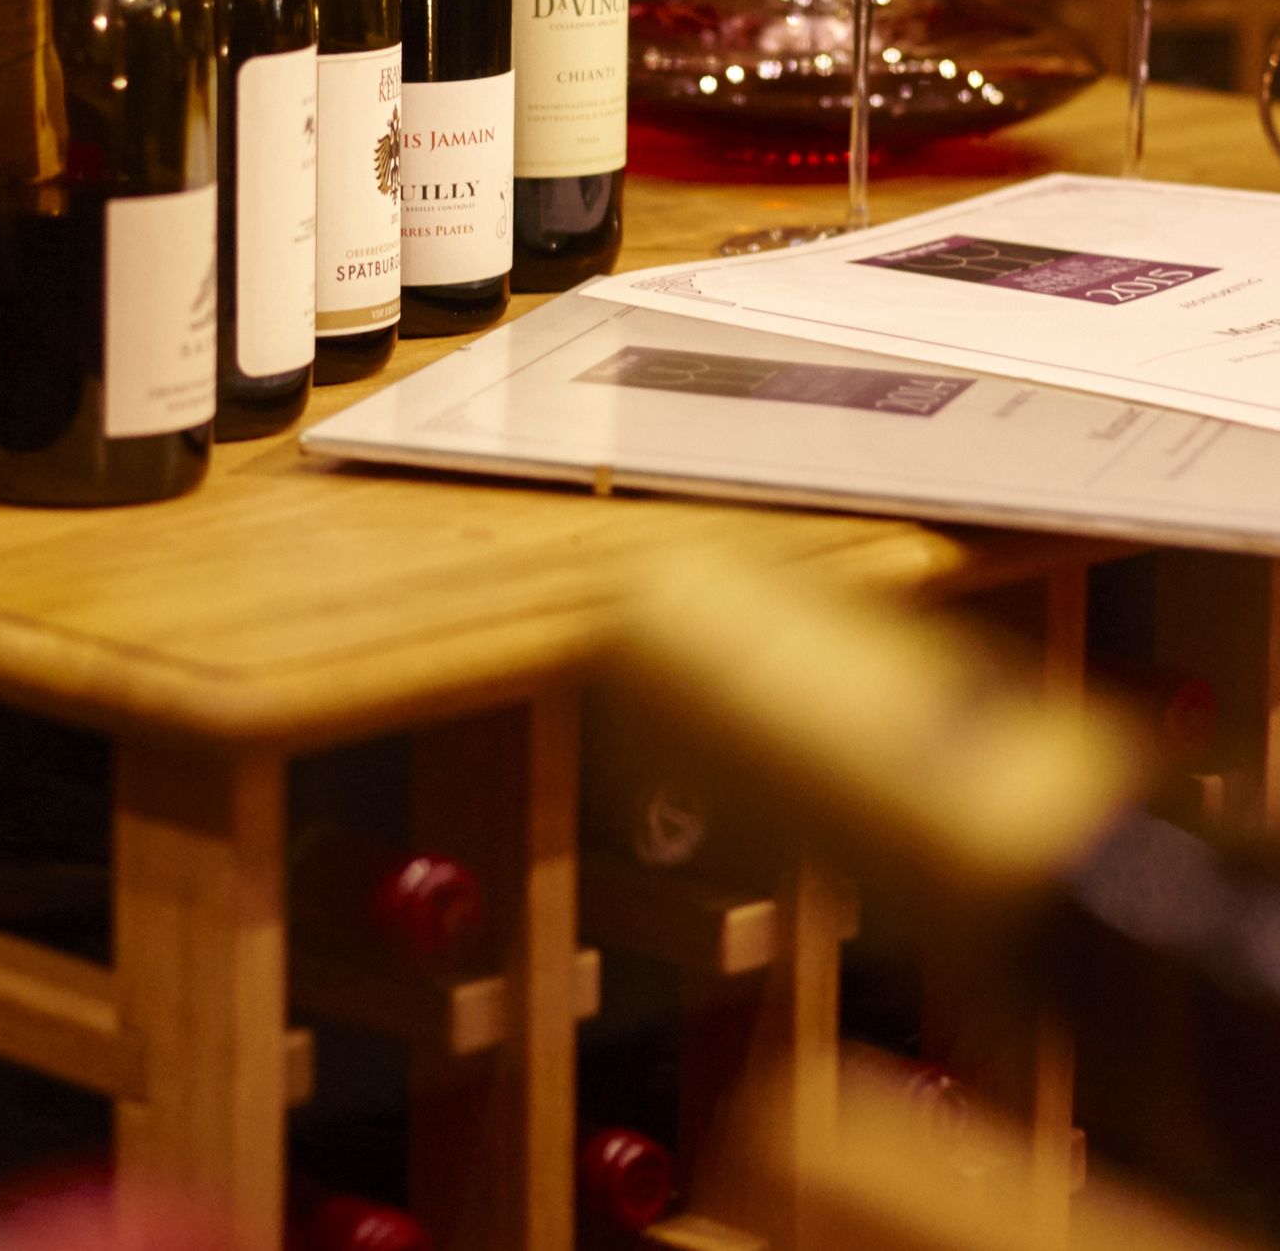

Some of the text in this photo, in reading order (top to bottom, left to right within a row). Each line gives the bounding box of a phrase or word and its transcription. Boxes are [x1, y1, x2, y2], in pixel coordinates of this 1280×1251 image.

[556, 66, 616, 84] CHIANTI
[431, 126, 495, 151] JAMAIN
[436, 223, 475, 237] PLATES
[1085, 248, 1194, 302] 2015
